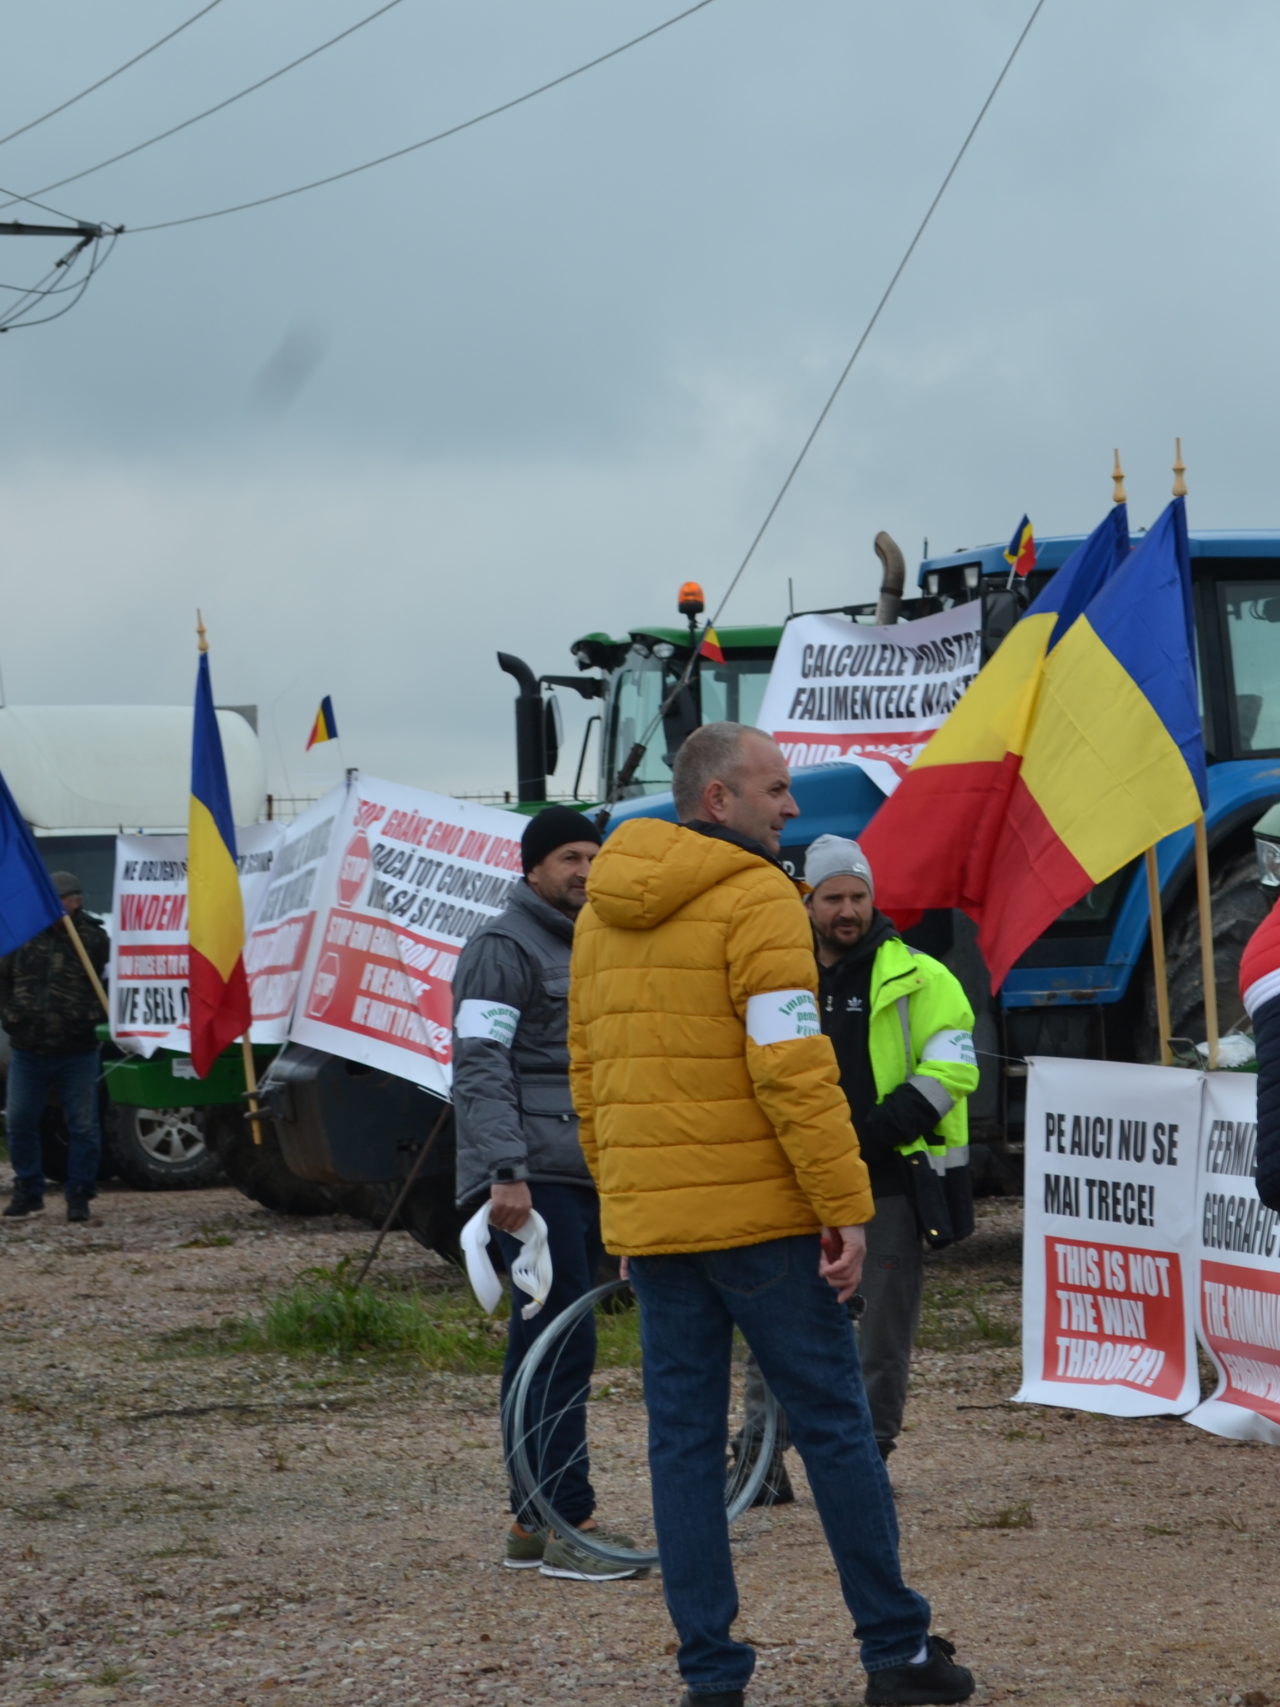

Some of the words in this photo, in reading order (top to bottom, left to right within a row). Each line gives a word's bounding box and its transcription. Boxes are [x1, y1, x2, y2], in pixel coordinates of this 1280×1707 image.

[801, 643, 909, 679] CALCULELE
[788, 684, 919, 721] FALIMENTELE
[922, 673, 981, 718] NOAST
[381, 809, 433, 847] GRÂNE
[426, 821, 464, 855] GMO
[457, 829, 491, 862] DIN
[122, 860, 139, 881] NE
[372, 842, 417, 880] DACĂ
[410, 856, 444, 890] TOT
[120, 894, 187, 931] VINDEM
[142, 986, 178, 1025] SELL
[1045, 1112, 1067, 1154] PE
[1070, 1114, 1113, 1159] AICI
[1118, 1118, 1147, 1164] NU
[1152, 1121, 1179, 1167] SE
[1044, 1172, 1080, 1218] MAI
[1085, 1177, 1155, 1228] TRECE!
[1054, 1243, 1101, 1289] THIS
[1102, 1249, 1127, 1293] IS
[1128, 1252, 1170, 1298] NOT
[1055, 1289, 1099, 1334] THE
[1096, 1295, 1148, 1341] WAY
[1203, 1280, 1230, 1338] THE
[1056, 1335, 1166, 1388] THROUGH!
